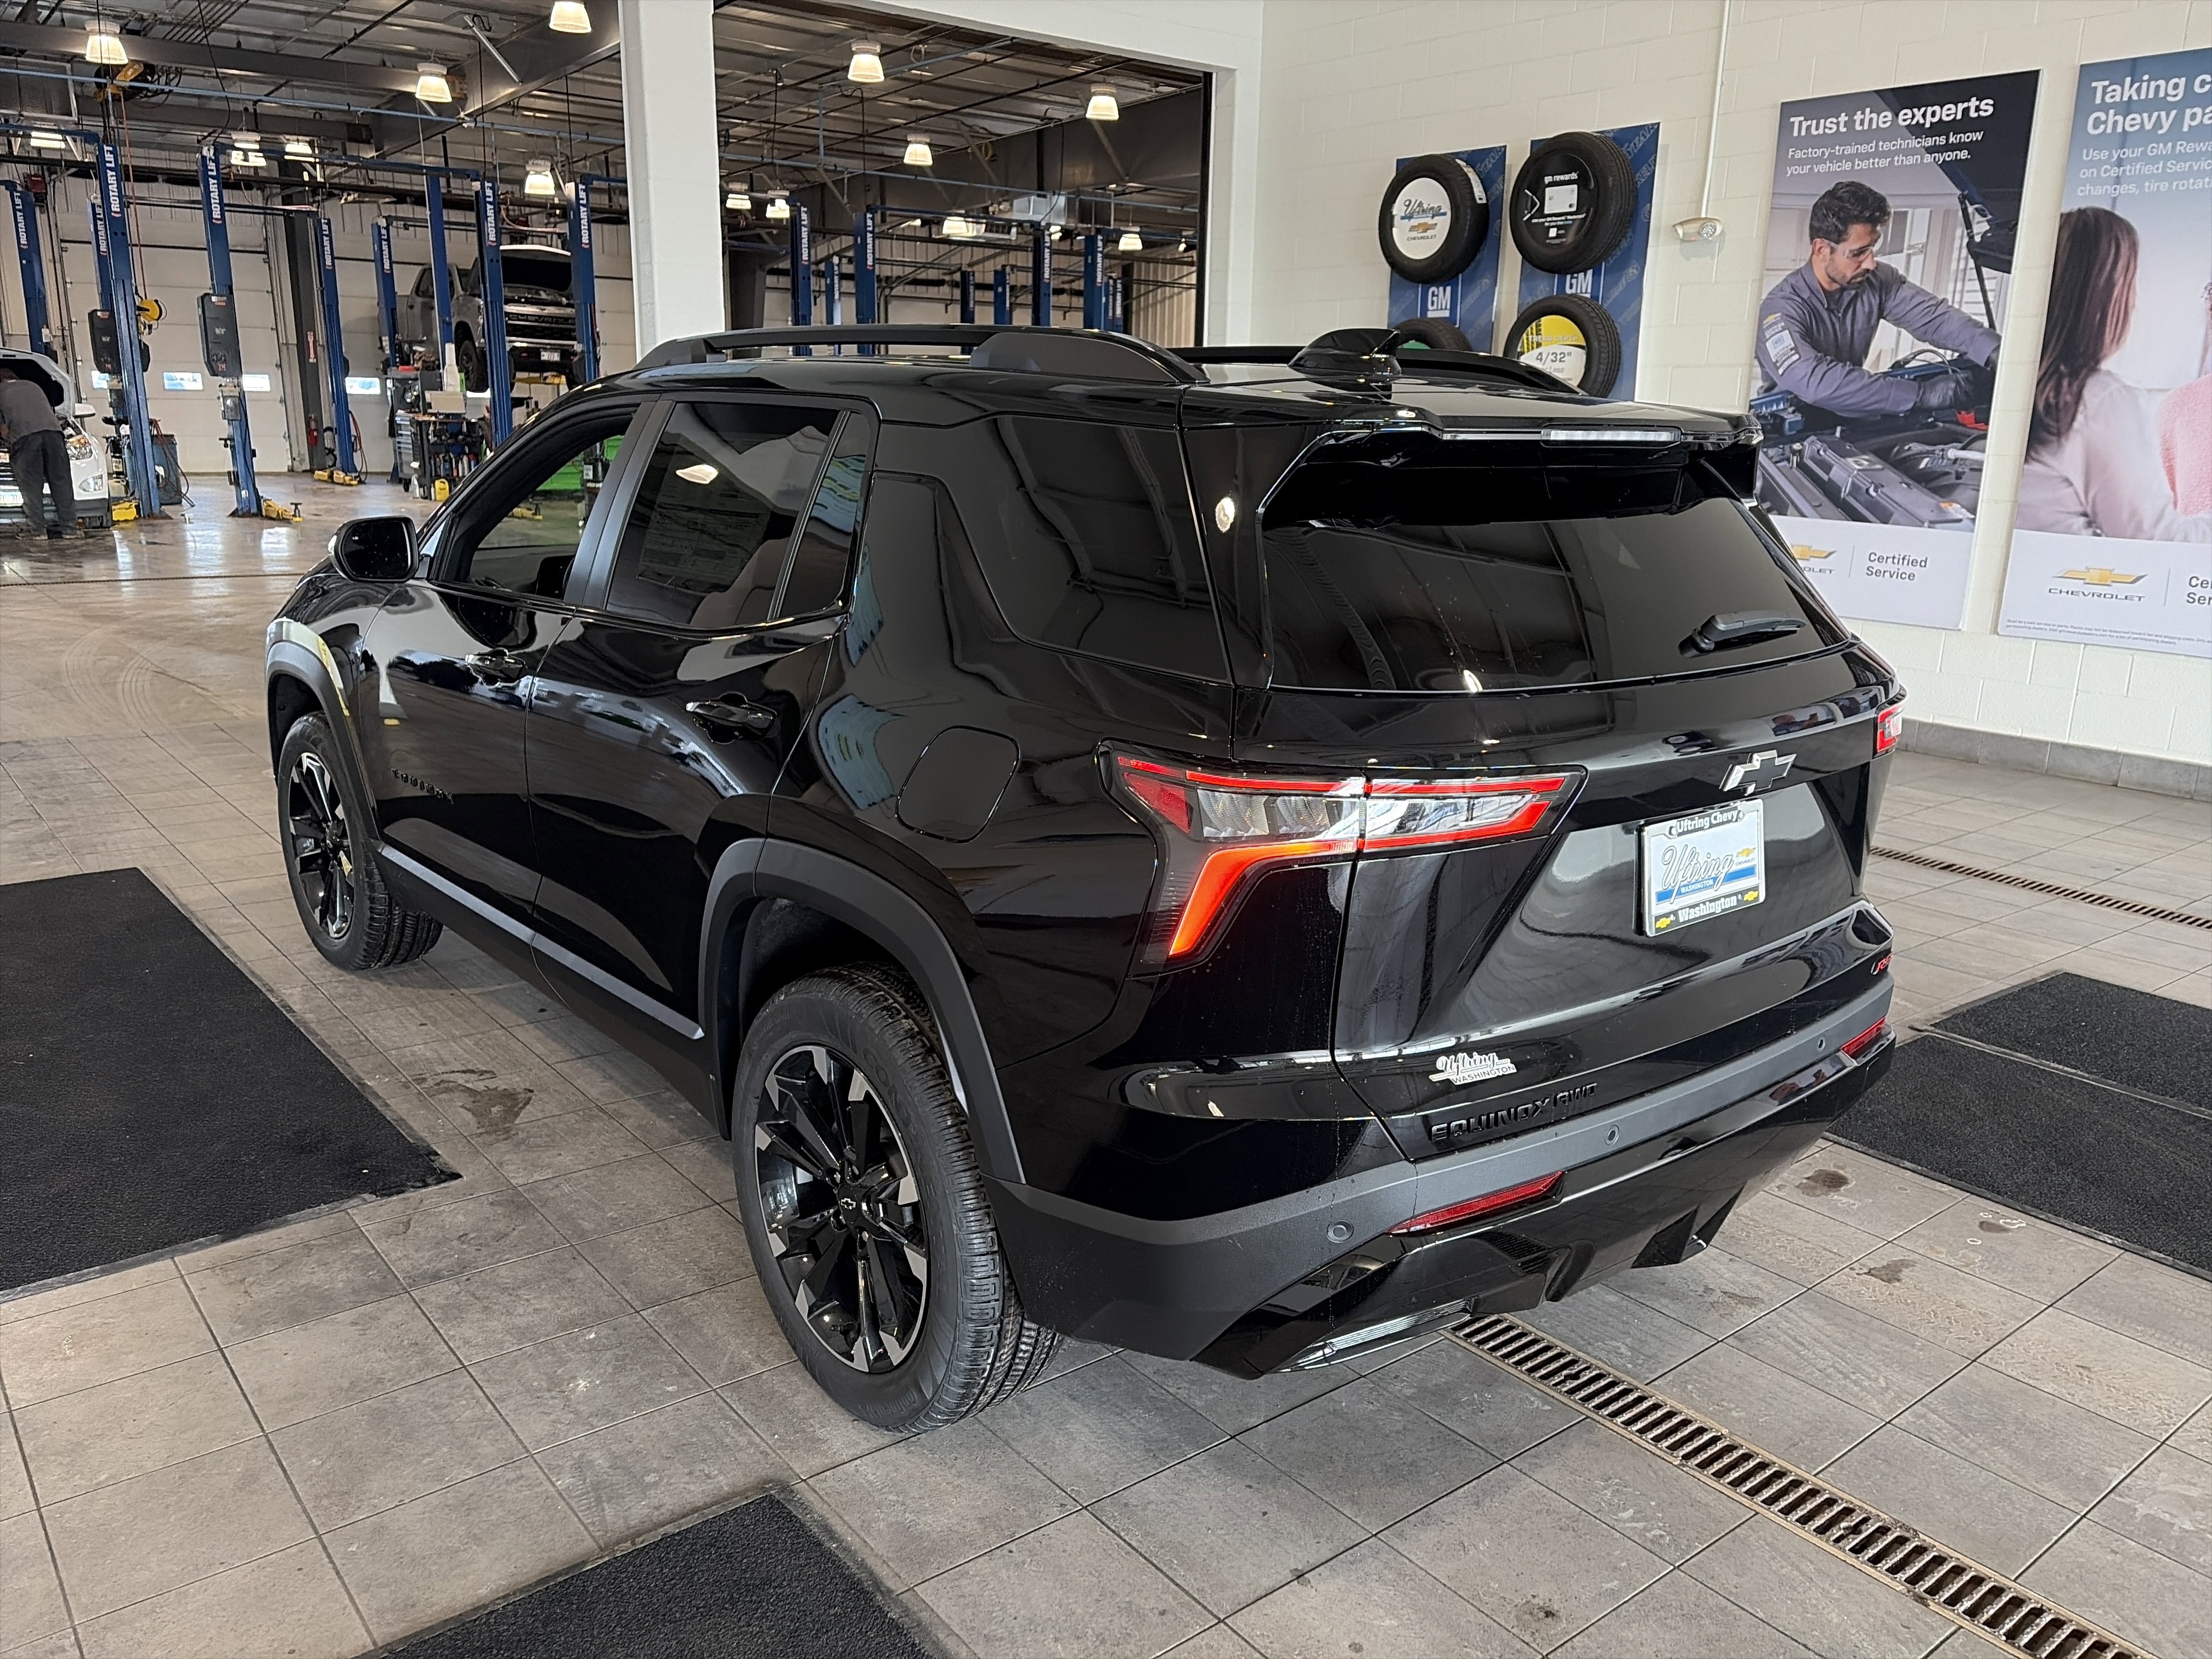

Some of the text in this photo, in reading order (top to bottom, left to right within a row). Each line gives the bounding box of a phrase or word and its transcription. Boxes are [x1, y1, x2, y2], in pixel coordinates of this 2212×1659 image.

[2091, 74, 2186, 104] Taking
[1789, 96, 1994, 137] Trust the experts
[2086, 109, 2177, 135] Chevy
[1788, 129, 1984, 159] Factory-trained technicians know
[2081, 148, 2109, 160] Use
[2111, 146, 2144, 162] your
[2147, 142, 2172, 156] GM
[1786, 148, 1971, 177] your vehicle better than anyone.
[2080, 168, 2097, 179] on
[2101, 160, 2163, 177] Certified
[103, 144, 120, 212] ROTARY LIFT
[2076, 183, 2139, 197] changes,
[2144, 179, 2169, 192] tire
[208, 177, 221, 219] ROTARY
[484, 180, 496, 241] ROTARY LIFT
[14, 191, 27, 245] ROTARY LIFT
[578, 183, 589, 244] ROTARY LIFT
[1565, 269, 1593, 294] GM
[1427, 285, 1451, 311] GM
[1868, 551, 1928, 568] Certified
[1865, 566, 1916, 581] Service
[2048, 588, 2146, 602] CHEVROLET
[1676, 810, 1738, 833] Uftring Chevy
[1662, 844, 1735, 904] Uftring
[1680, 878, 1714, 894] WASHINGTON
[1678, 895, 1737, 923] Washington
[1452, 1065, 1515, 1084] WASHINGTON
[1429, 1083, 1598, 1143] EQUINOX AWD
